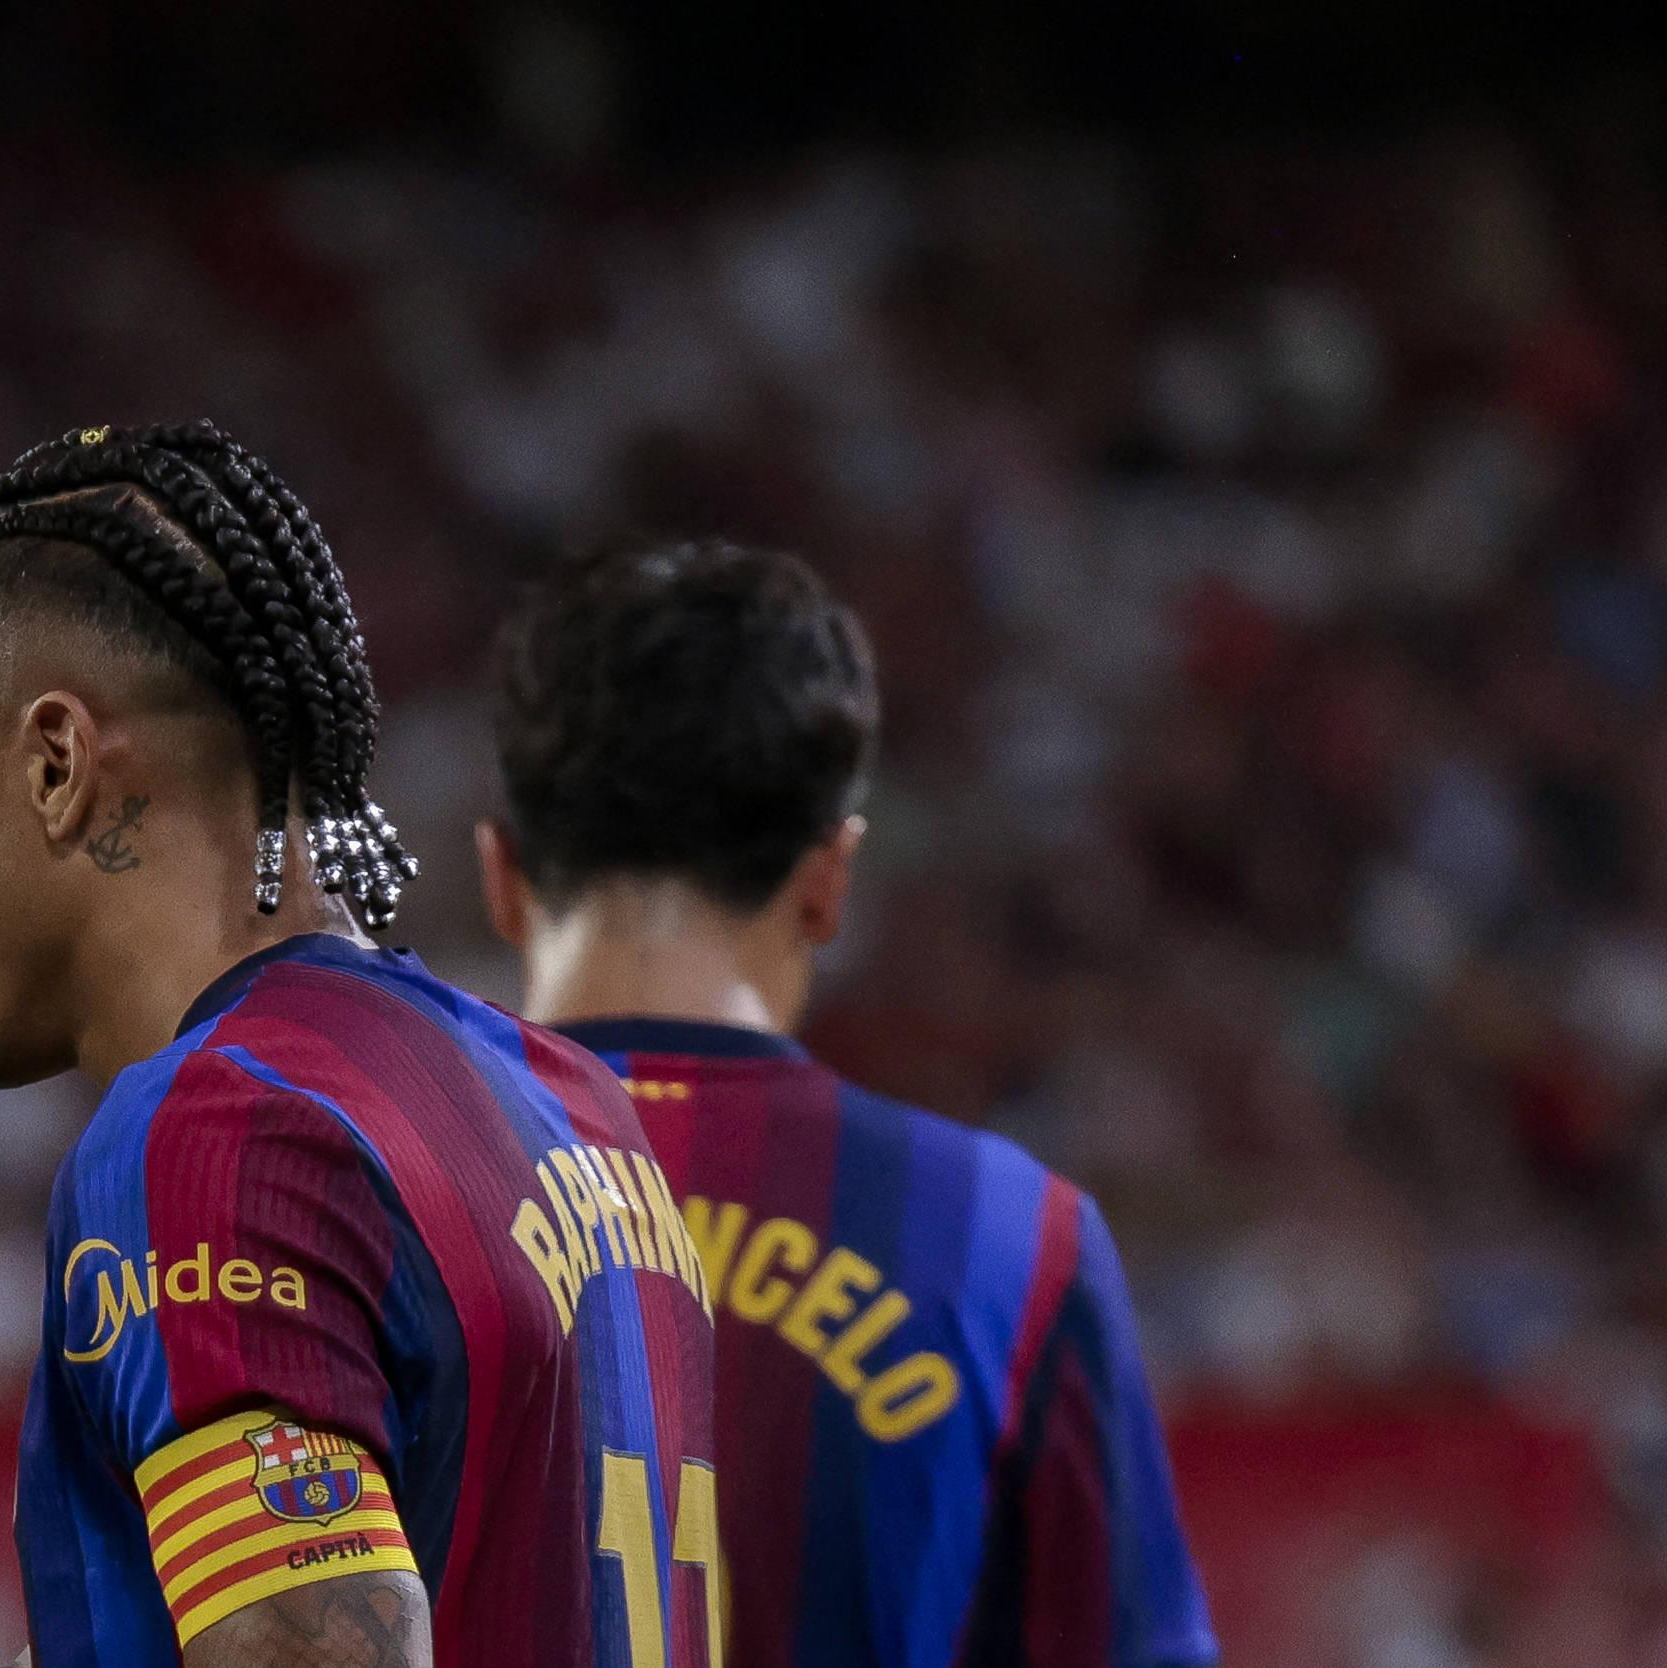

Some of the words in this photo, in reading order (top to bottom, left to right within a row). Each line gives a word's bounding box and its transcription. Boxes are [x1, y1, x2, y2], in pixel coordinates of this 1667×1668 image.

[63, 1238, 307, 1363] Midea
[681, 1196, 961, 1444] NCELO
[289, 1457, 331, 1477] FCB
